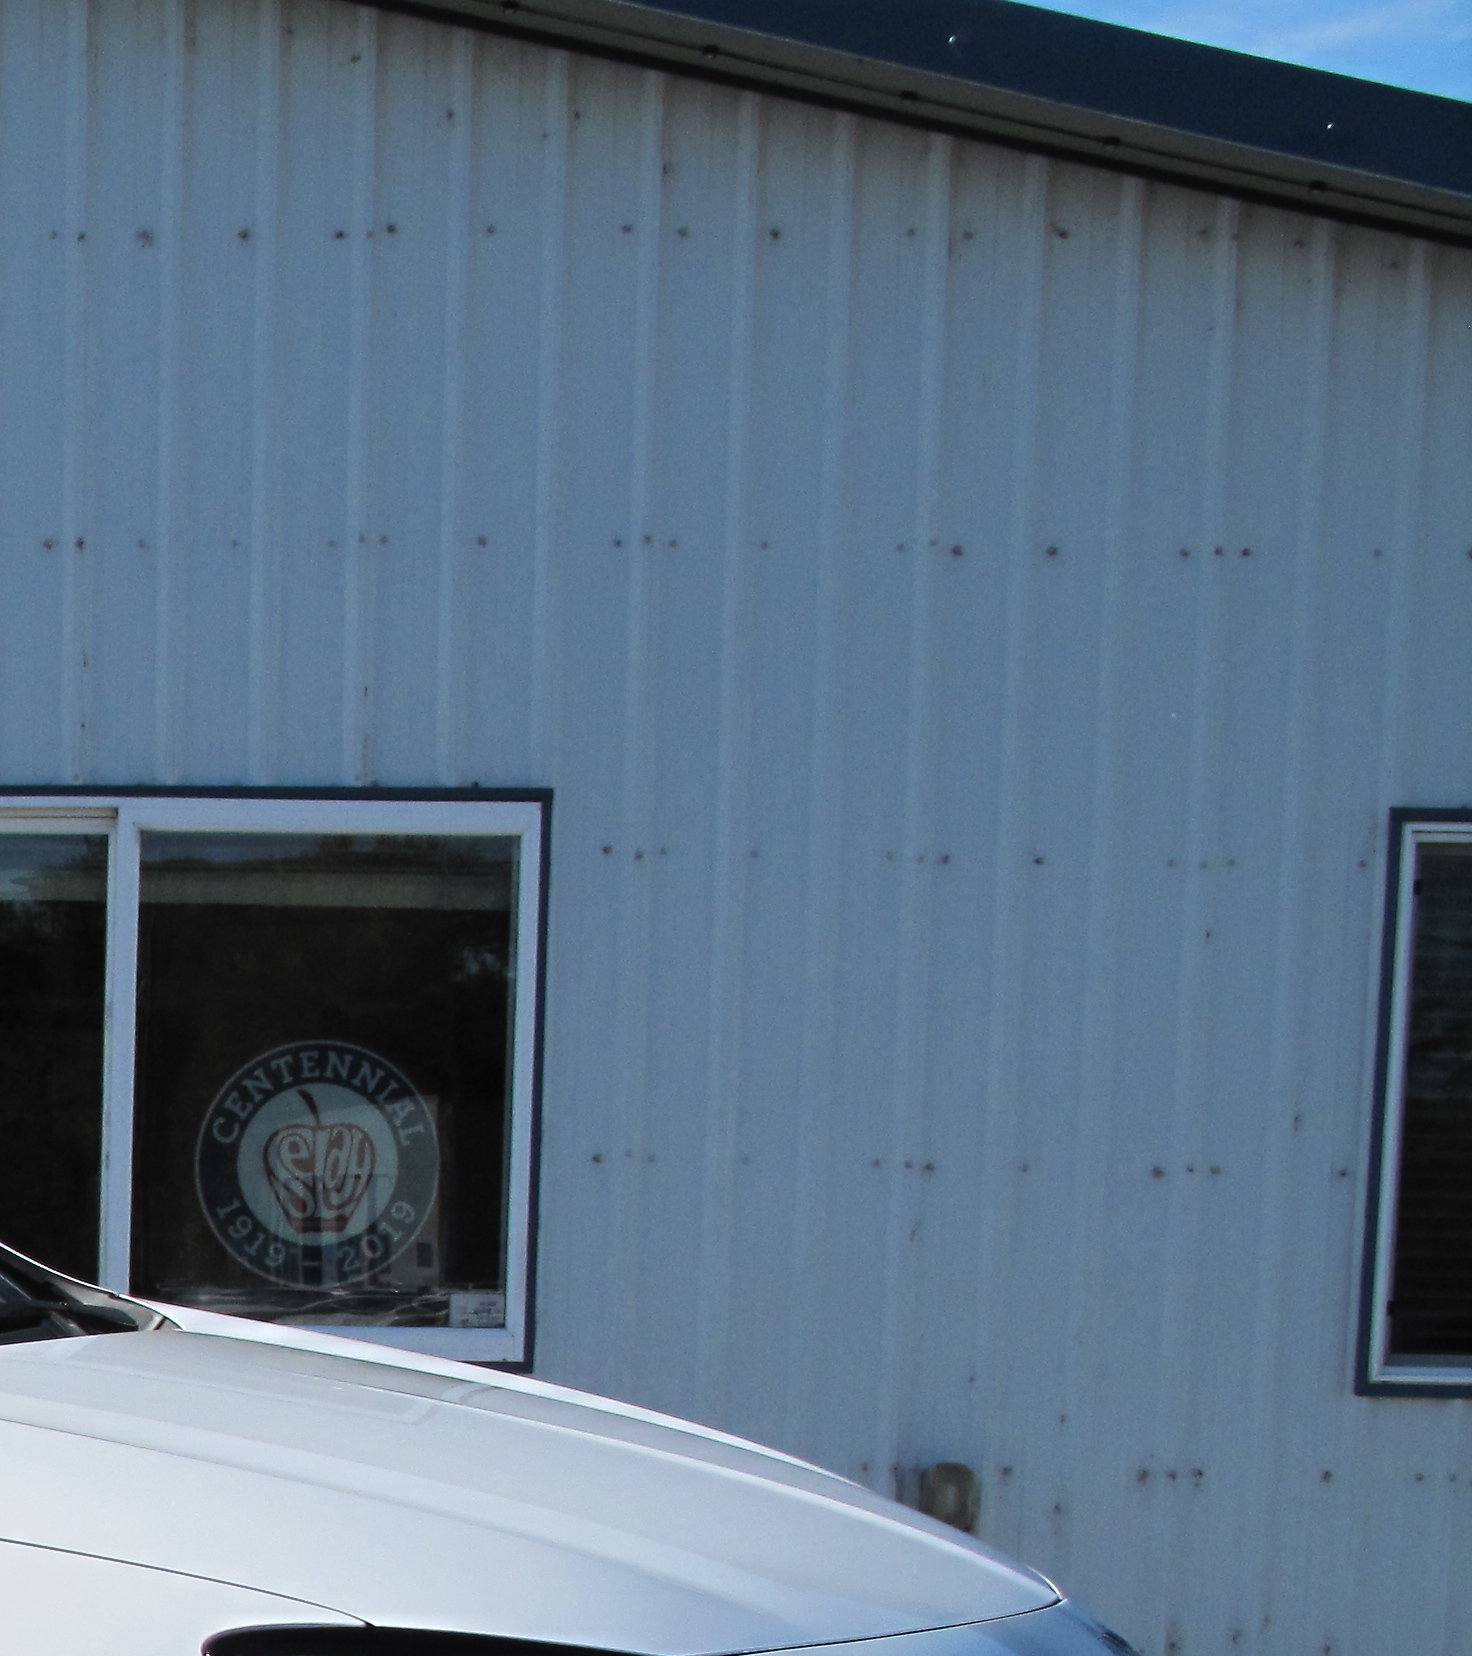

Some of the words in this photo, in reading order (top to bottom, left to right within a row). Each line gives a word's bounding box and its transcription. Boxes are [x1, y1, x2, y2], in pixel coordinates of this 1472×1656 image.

[213, 1051, 425, 1147] CENTENNIAL
[218, 1200, 286, 1268] 1919
[338, 1200, 415, 1272] 2019
